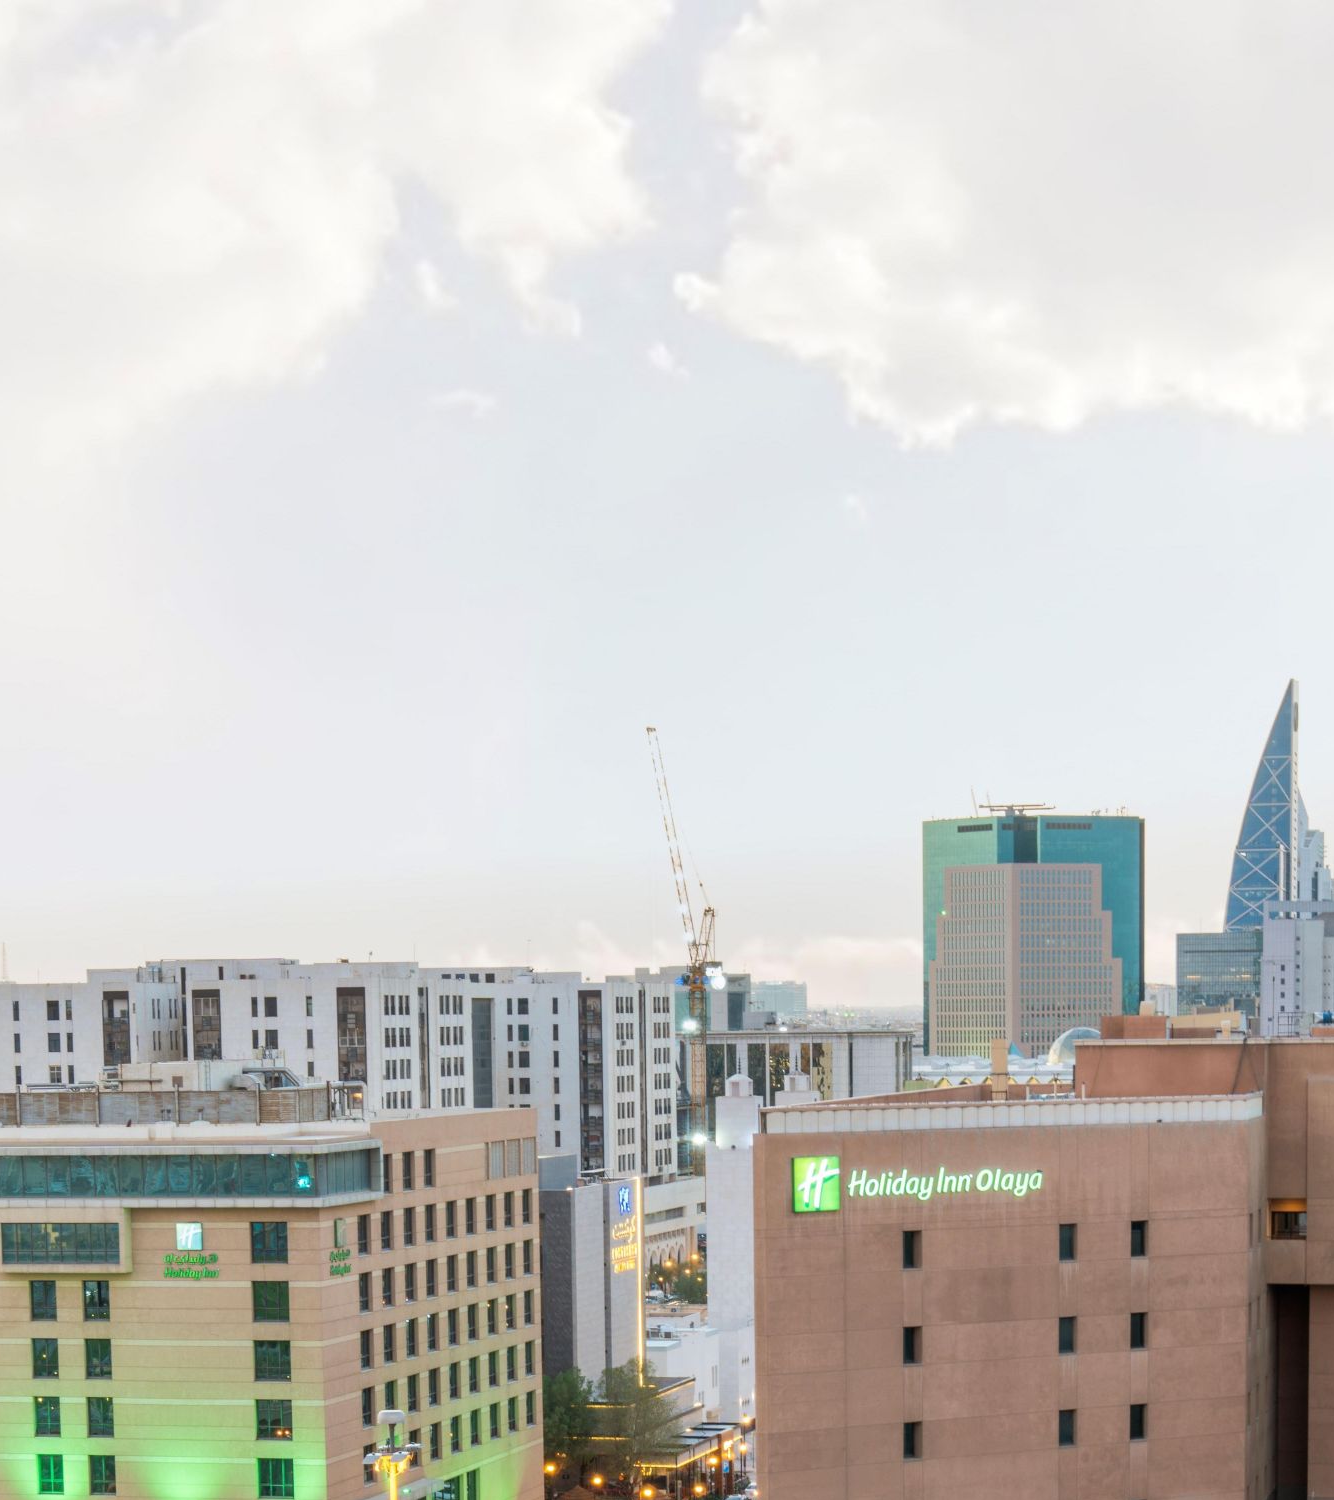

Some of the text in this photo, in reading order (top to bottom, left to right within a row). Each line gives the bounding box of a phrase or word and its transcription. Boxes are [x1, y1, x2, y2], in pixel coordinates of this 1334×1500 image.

[848, 1168, 934, 1201] Holiday
[936, 1166, 972, 1194] Inn
[975, 1168, 1043, 1197] Olaya
